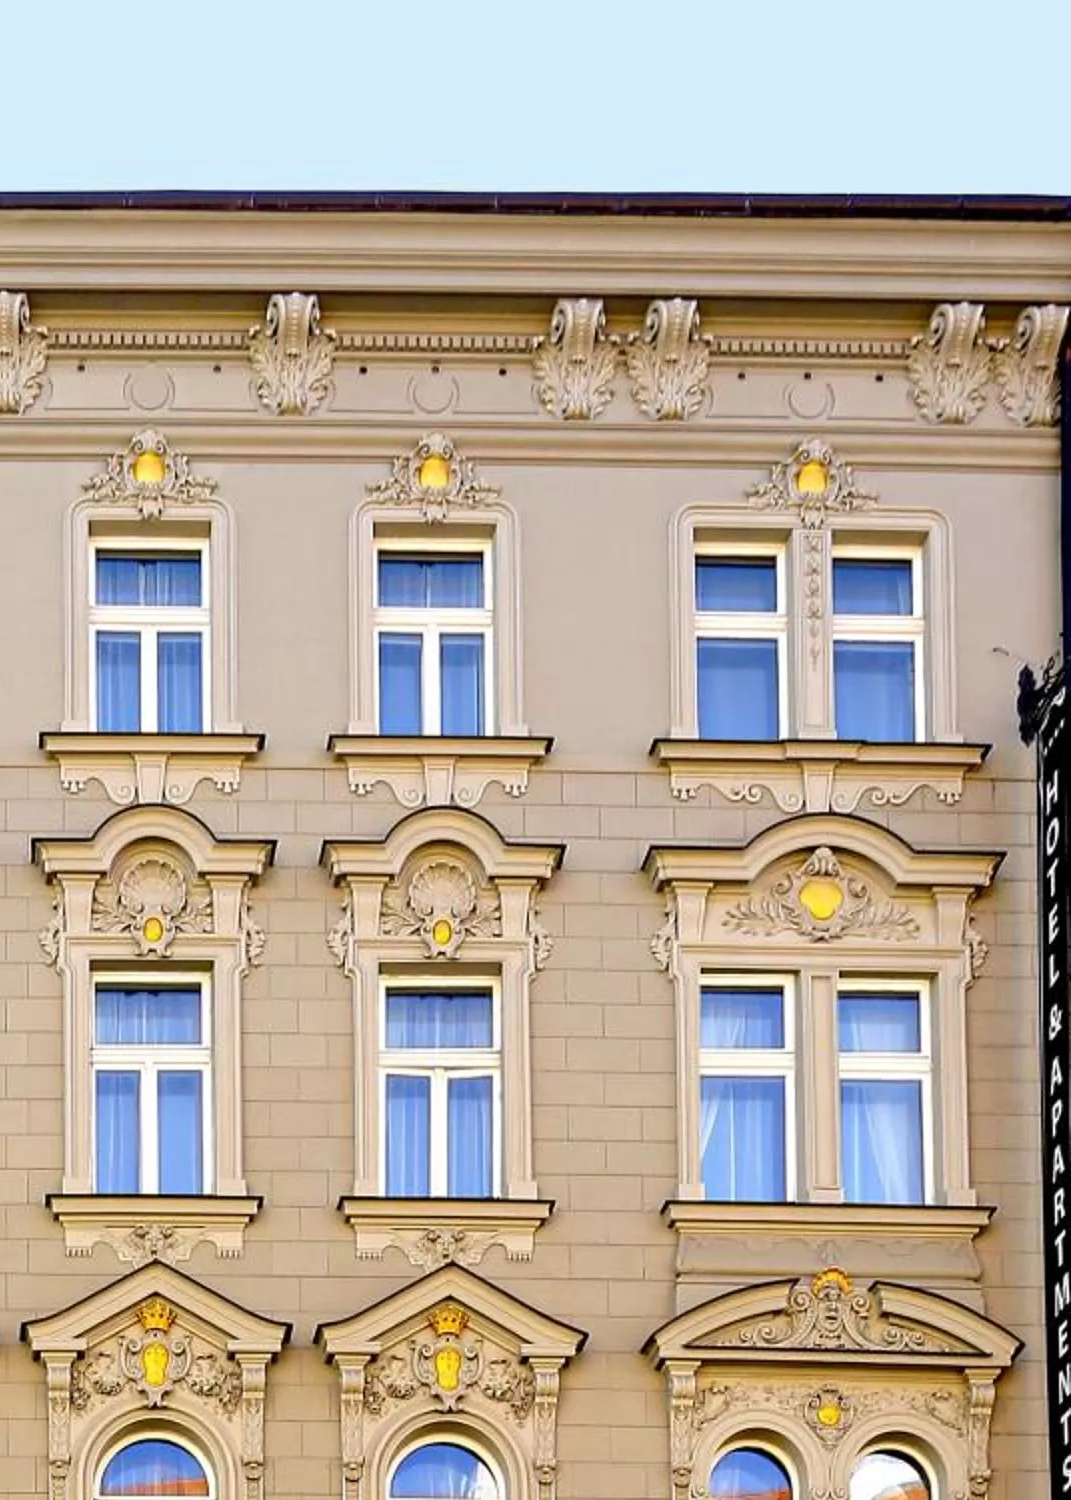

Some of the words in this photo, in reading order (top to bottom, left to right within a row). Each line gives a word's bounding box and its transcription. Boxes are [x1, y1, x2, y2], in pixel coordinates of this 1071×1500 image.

[1046, 769, 1060, 989] HOTEL
[1048, 1002, 1063, 1042] &
[1050, 1055, 1071, 1493] APARTMENTS
